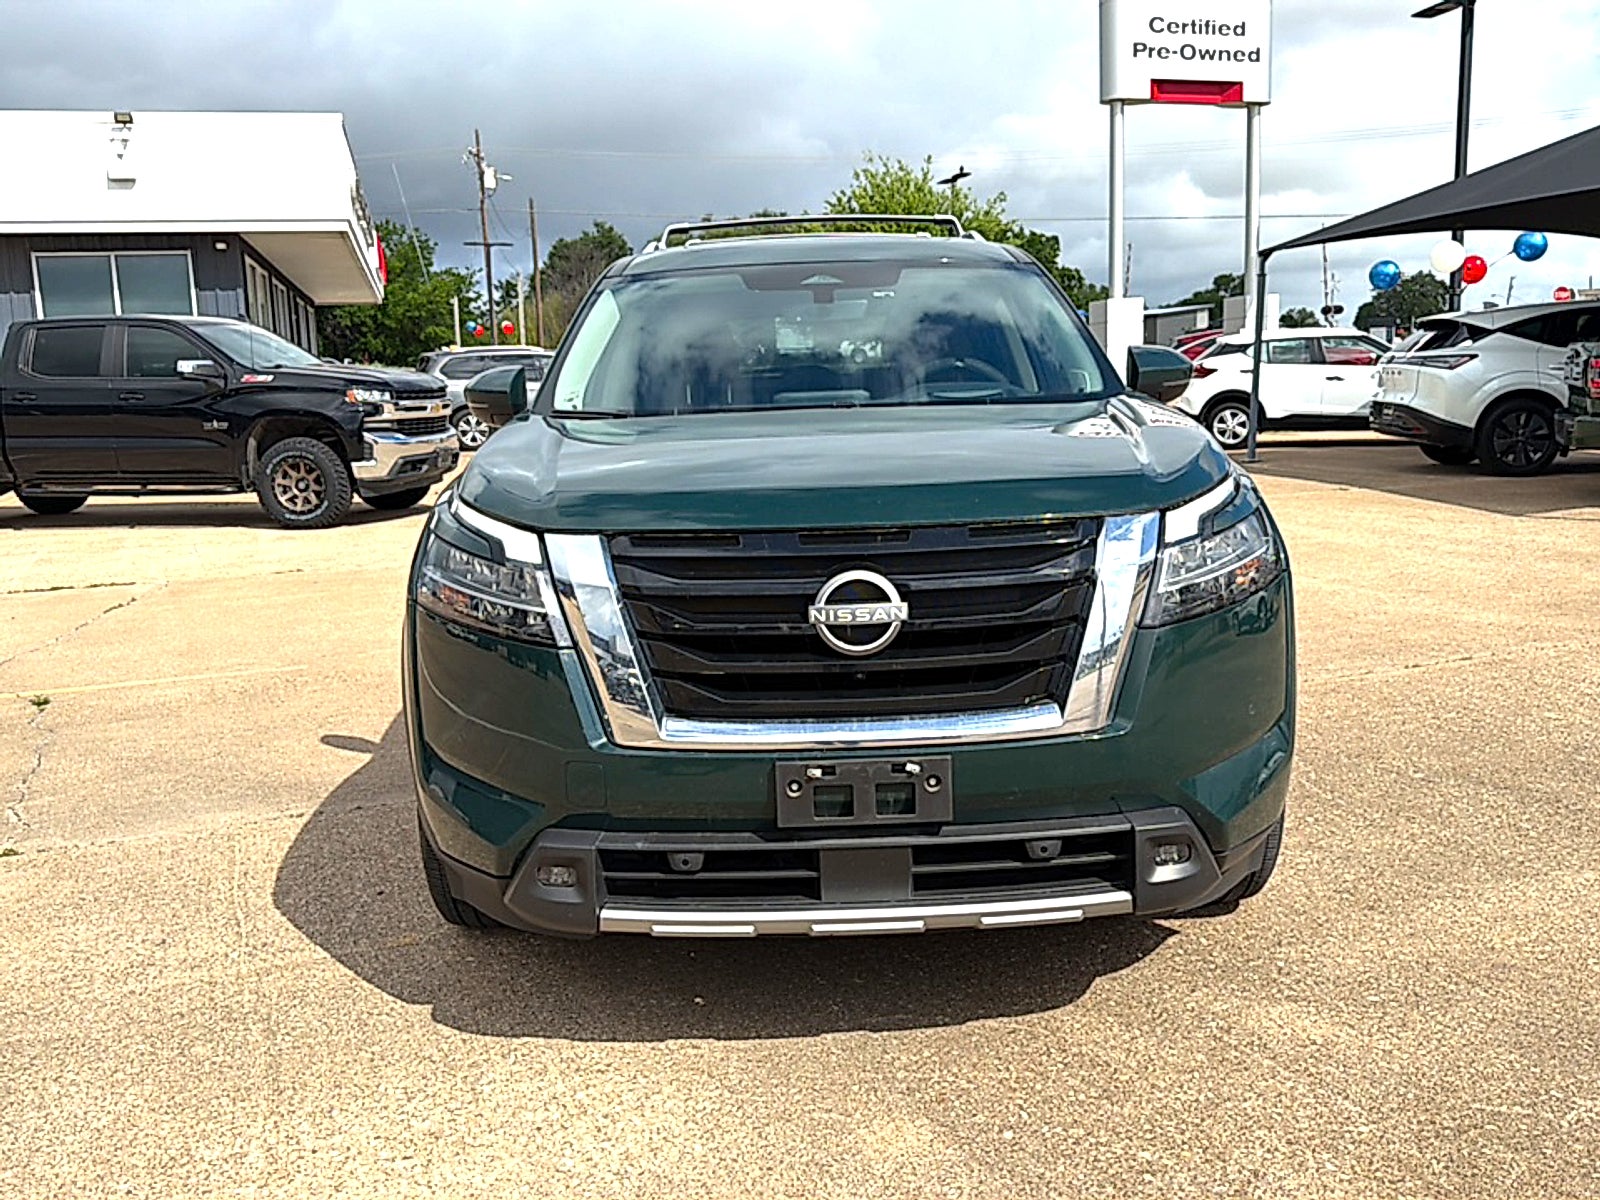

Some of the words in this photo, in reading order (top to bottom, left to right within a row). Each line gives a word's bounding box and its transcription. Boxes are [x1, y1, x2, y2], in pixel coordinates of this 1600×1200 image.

[1149, 16, 1246, 37] Certified
[1132, 42, 1261, 63] Pre-Owned
[810, 606, 907, 622] NISSAN
